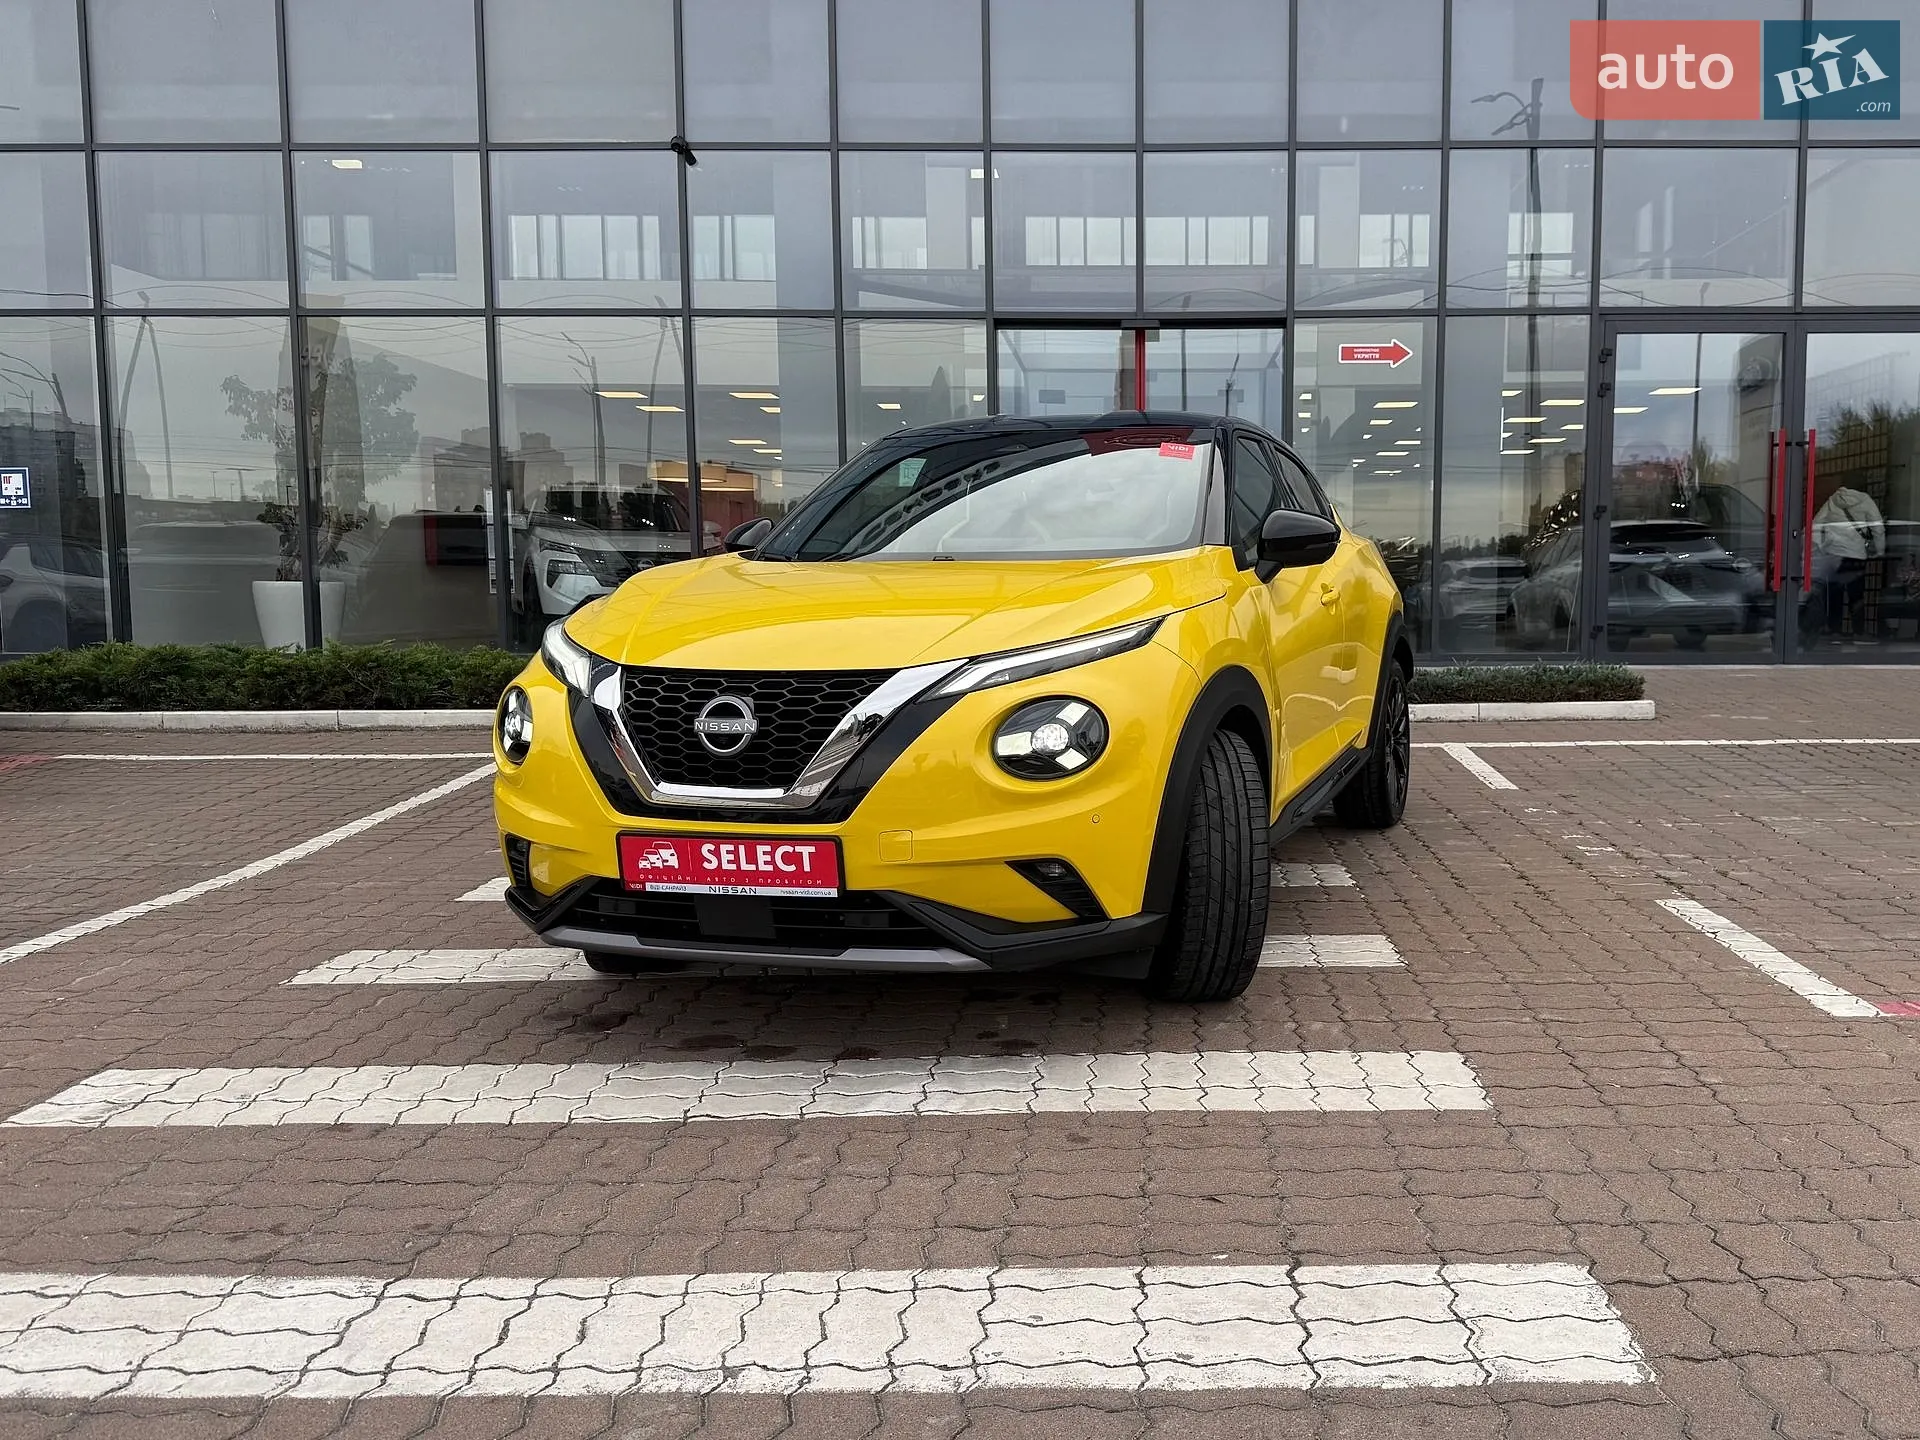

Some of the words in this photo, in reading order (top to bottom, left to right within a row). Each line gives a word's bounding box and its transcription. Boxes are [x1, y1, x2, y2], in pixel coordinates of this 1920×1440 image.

[695, 721, 755, 731] NISSAN
[701, 843, 816, 872] SELECT
[708, 886, 757, 894] NISSAN
